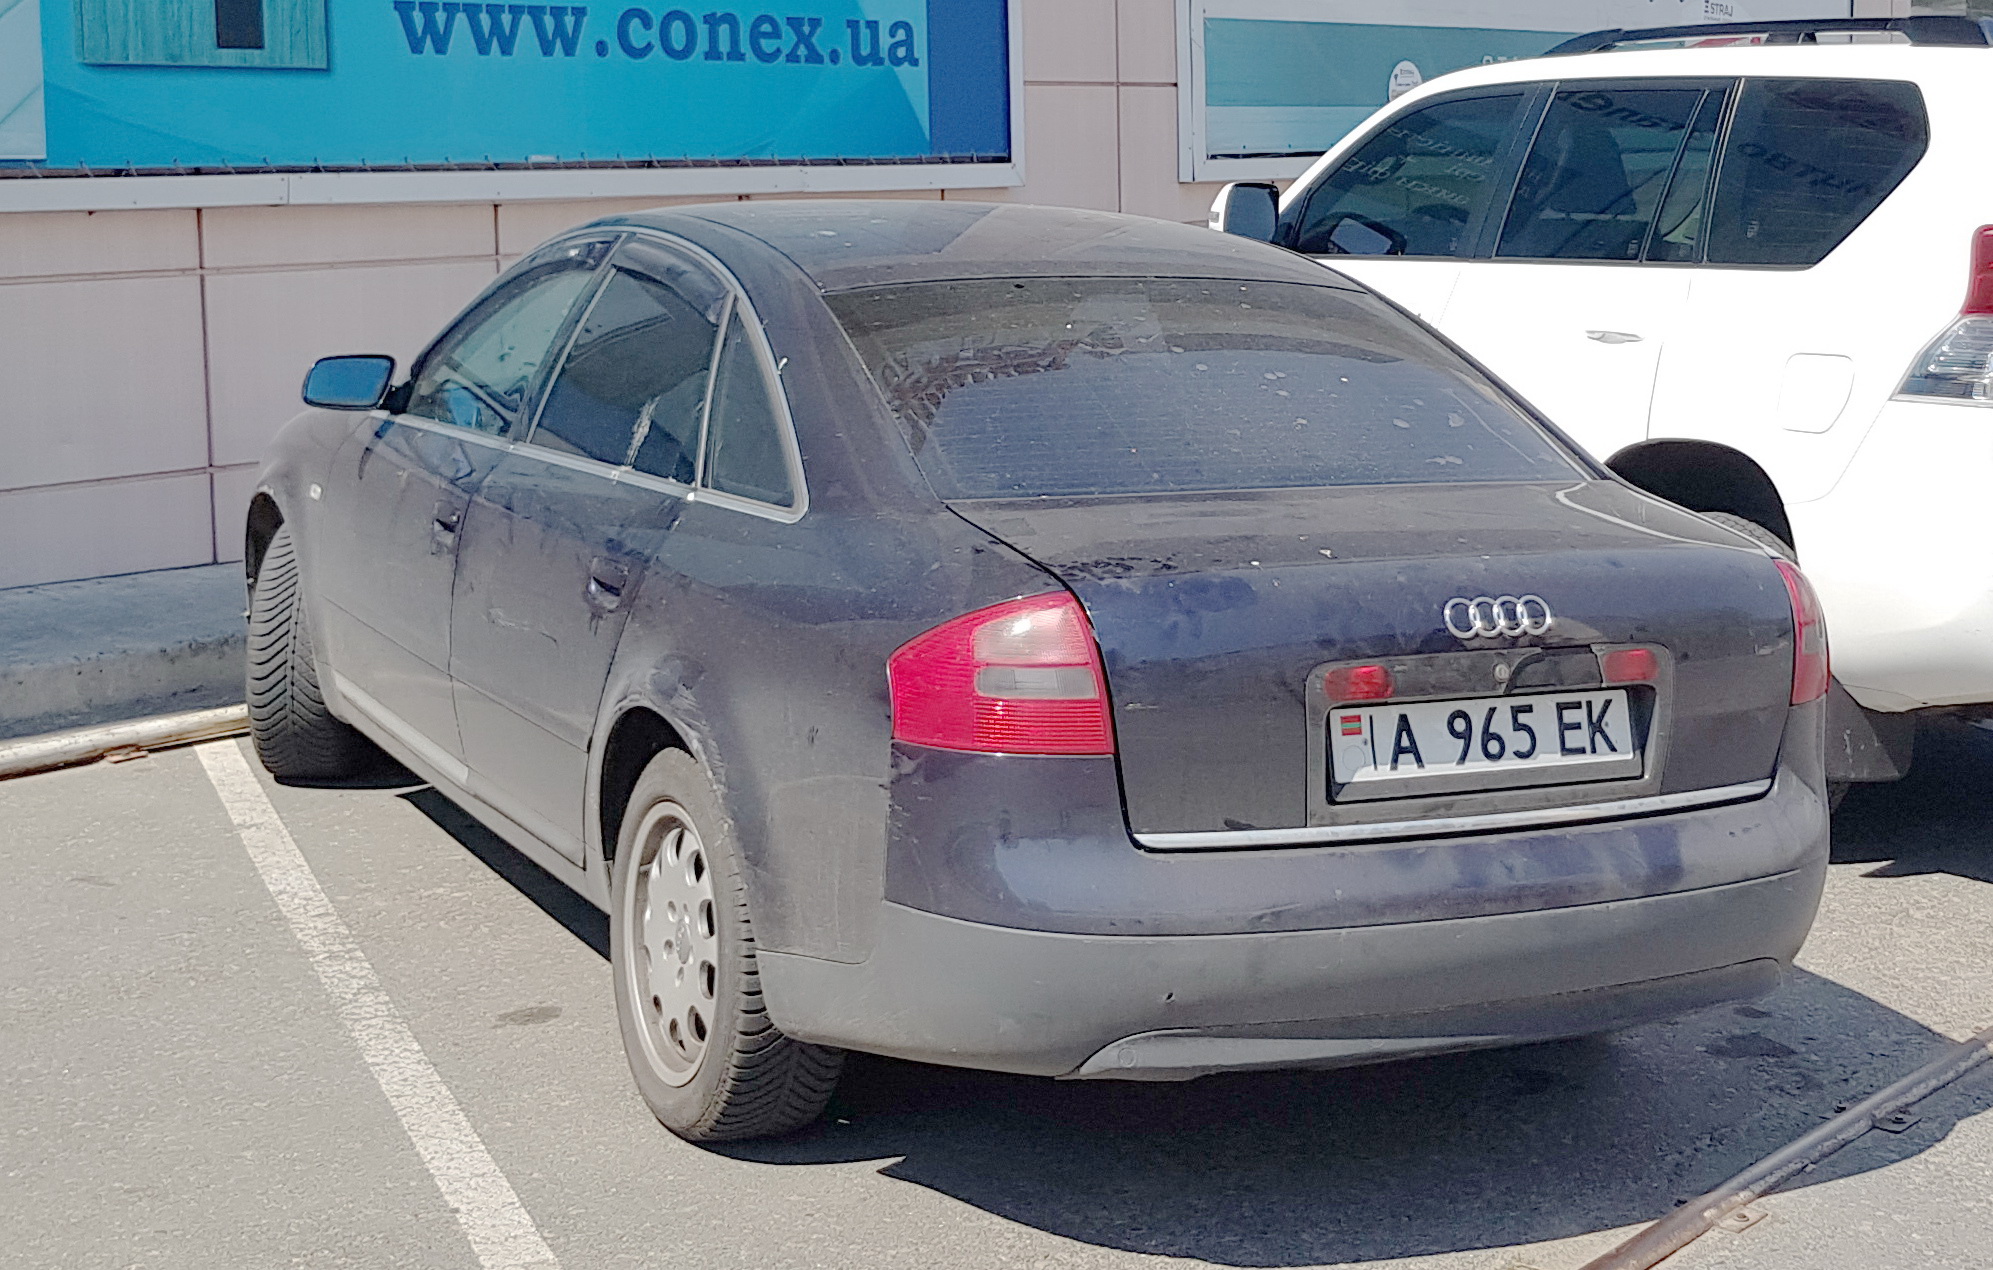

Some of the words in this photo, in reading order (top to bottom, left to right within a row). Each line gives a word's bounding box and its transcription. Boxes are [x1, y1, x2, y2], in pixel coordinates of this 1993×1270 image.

[394, 0, 919, 67] www.conex.ua
[1446, 704, 1537, 766] 965
[1555, 699, 1618, 757] EK
